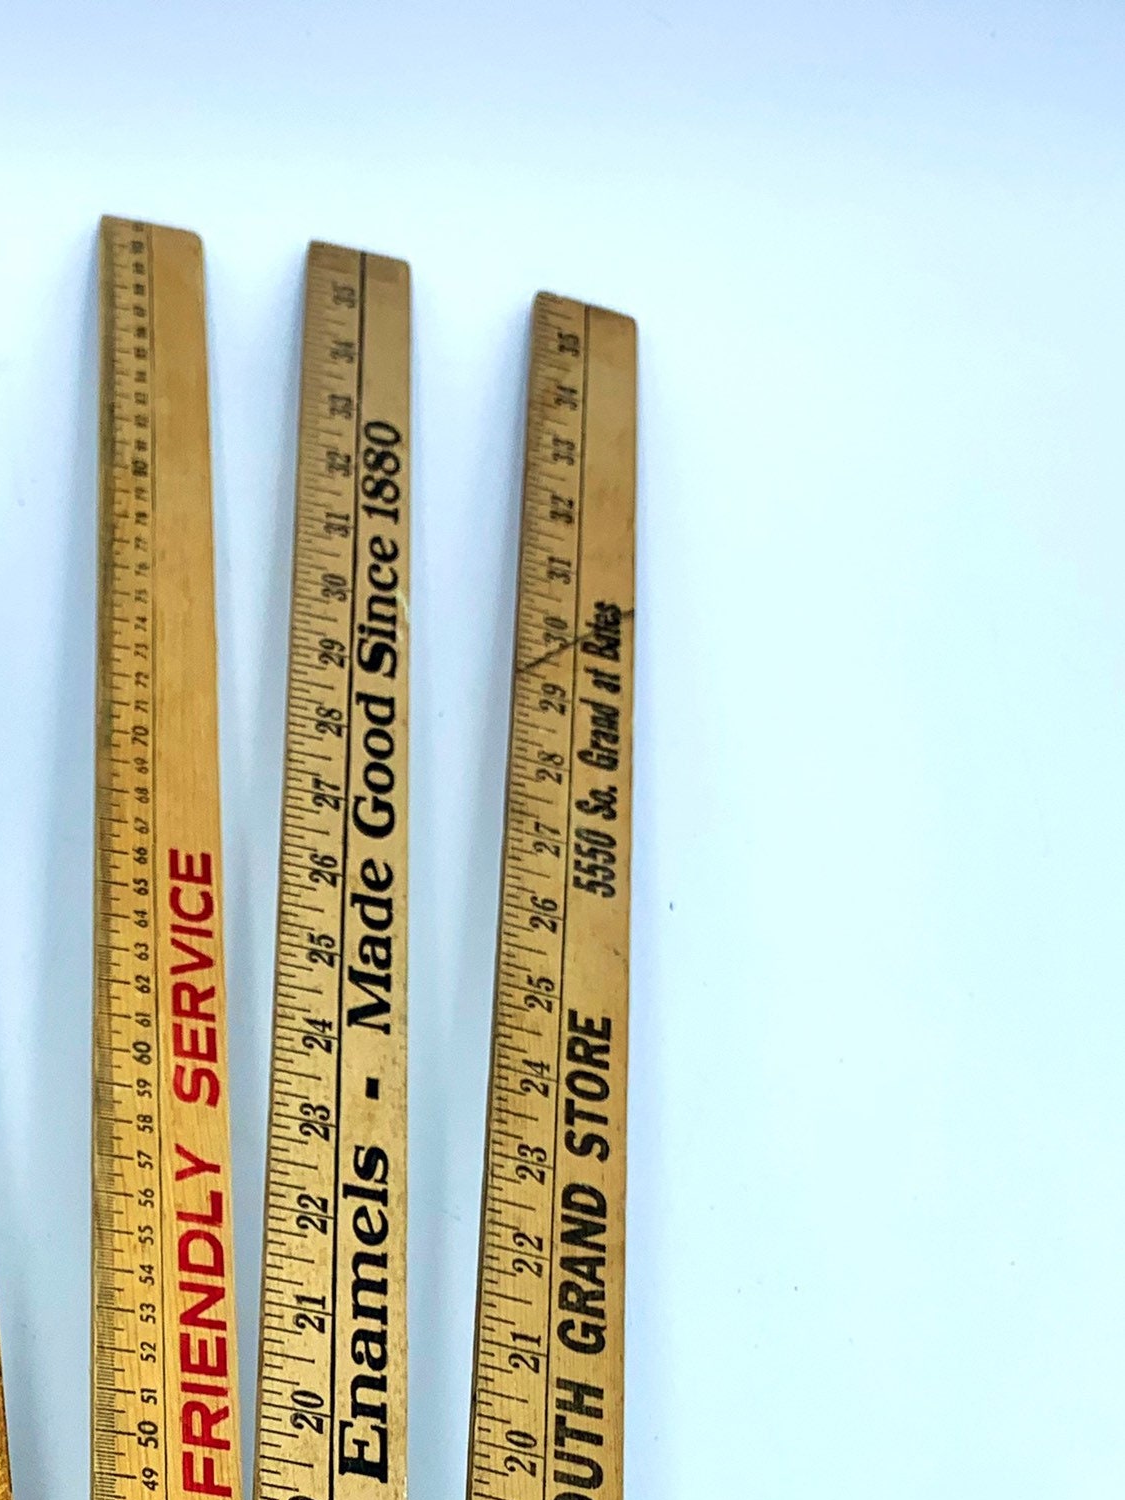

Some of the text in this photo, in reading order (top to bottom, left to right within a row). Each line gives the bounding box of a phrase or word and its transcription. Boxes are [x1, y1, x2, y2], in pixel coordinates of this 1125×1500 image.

[322, 573, 347, 602] 30
[584, 666, 621, 694] at
[539, 683, 566, 716] 29
[132, 725, 150, 747] 70
[315, 707, 343, 738] 28
[347, 420, 401, 1036] Made Good Since 1880
[577, 697, 620, 772] Grand
[135, 787, 150, 804] 68
[575, 785, 618, 821] So.
[132, 846, 148, 865] 66
[533, 822, 562, 858] 27
[309, 853, 338, 888] 26
[573, 827, 616, 899] 5550
[134, 909, 149, 929] 64
[135, 974, 151, 994] 62
[524, 974, 555, 1013] 25
[132, 1040, 152, 1066] 60
[302, 1017, 333, 1054] 24
[563, 1008, 612, 1163] STORE
[137, 1114, 153, 1134] 58
[168, 848, 232, 1498] FRIENDLY SERVICE
[515, 1144, 547, 1185] 23
[138, 1188, 155, 1209] 56
[296, 1193, 328, 1235] 22
[512, 1232, 543, 1278] 22
[557, 1182, 607, 1355] GRAND
[139, 1264, 155, 1286] 54
[338, 1145, 389, 1484] Enamels
[140, 1341, 157, 1363] 52
[290, 1389, 324, 1434] 20
[137, 1420, 159, 1449] 50
[504, 1429, 537, 1478] 20
